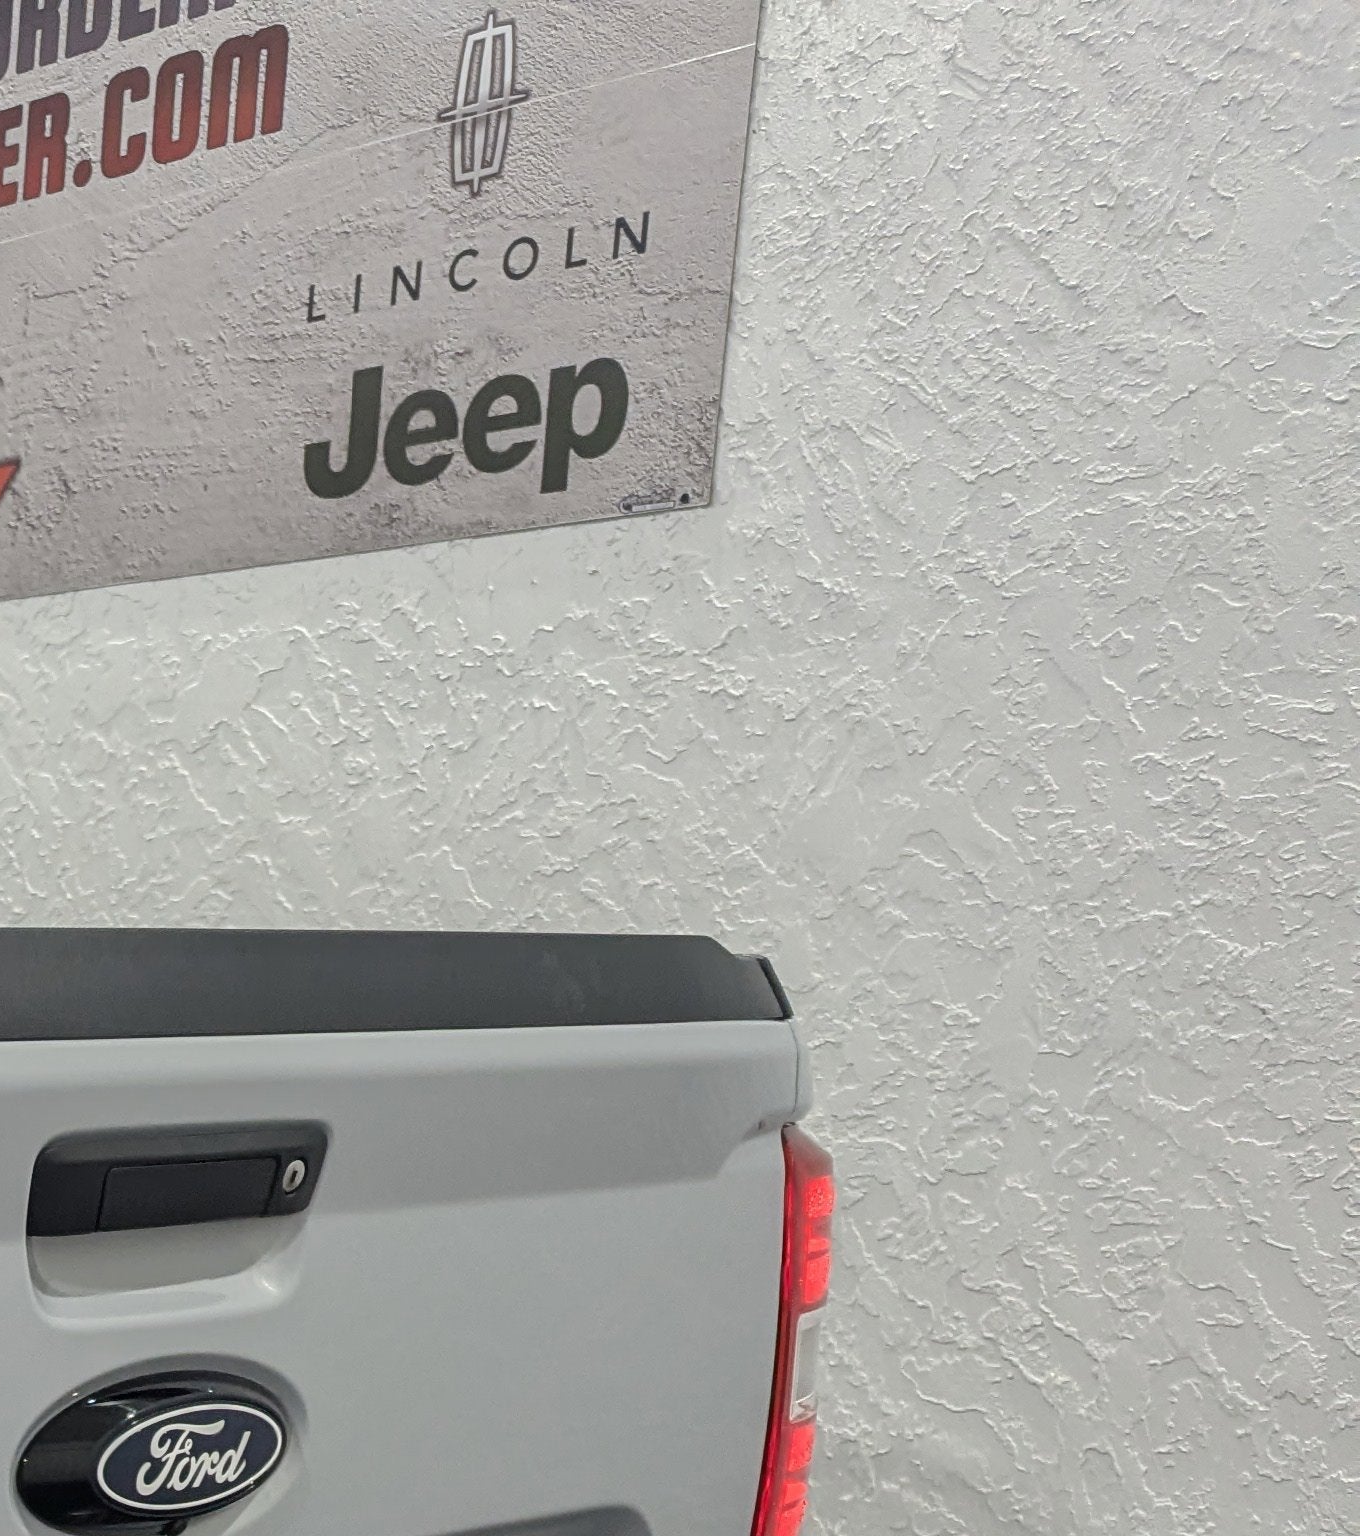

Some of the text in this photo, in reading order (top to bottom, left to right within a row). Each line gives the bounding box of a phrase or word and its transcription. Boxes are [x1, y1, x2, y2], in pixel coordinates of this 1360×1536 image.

[305, 210, 651, 323] LINCOLN
[303, 357, 629, 499] Jeep
[135, 1419, 251, 1497] Ford
